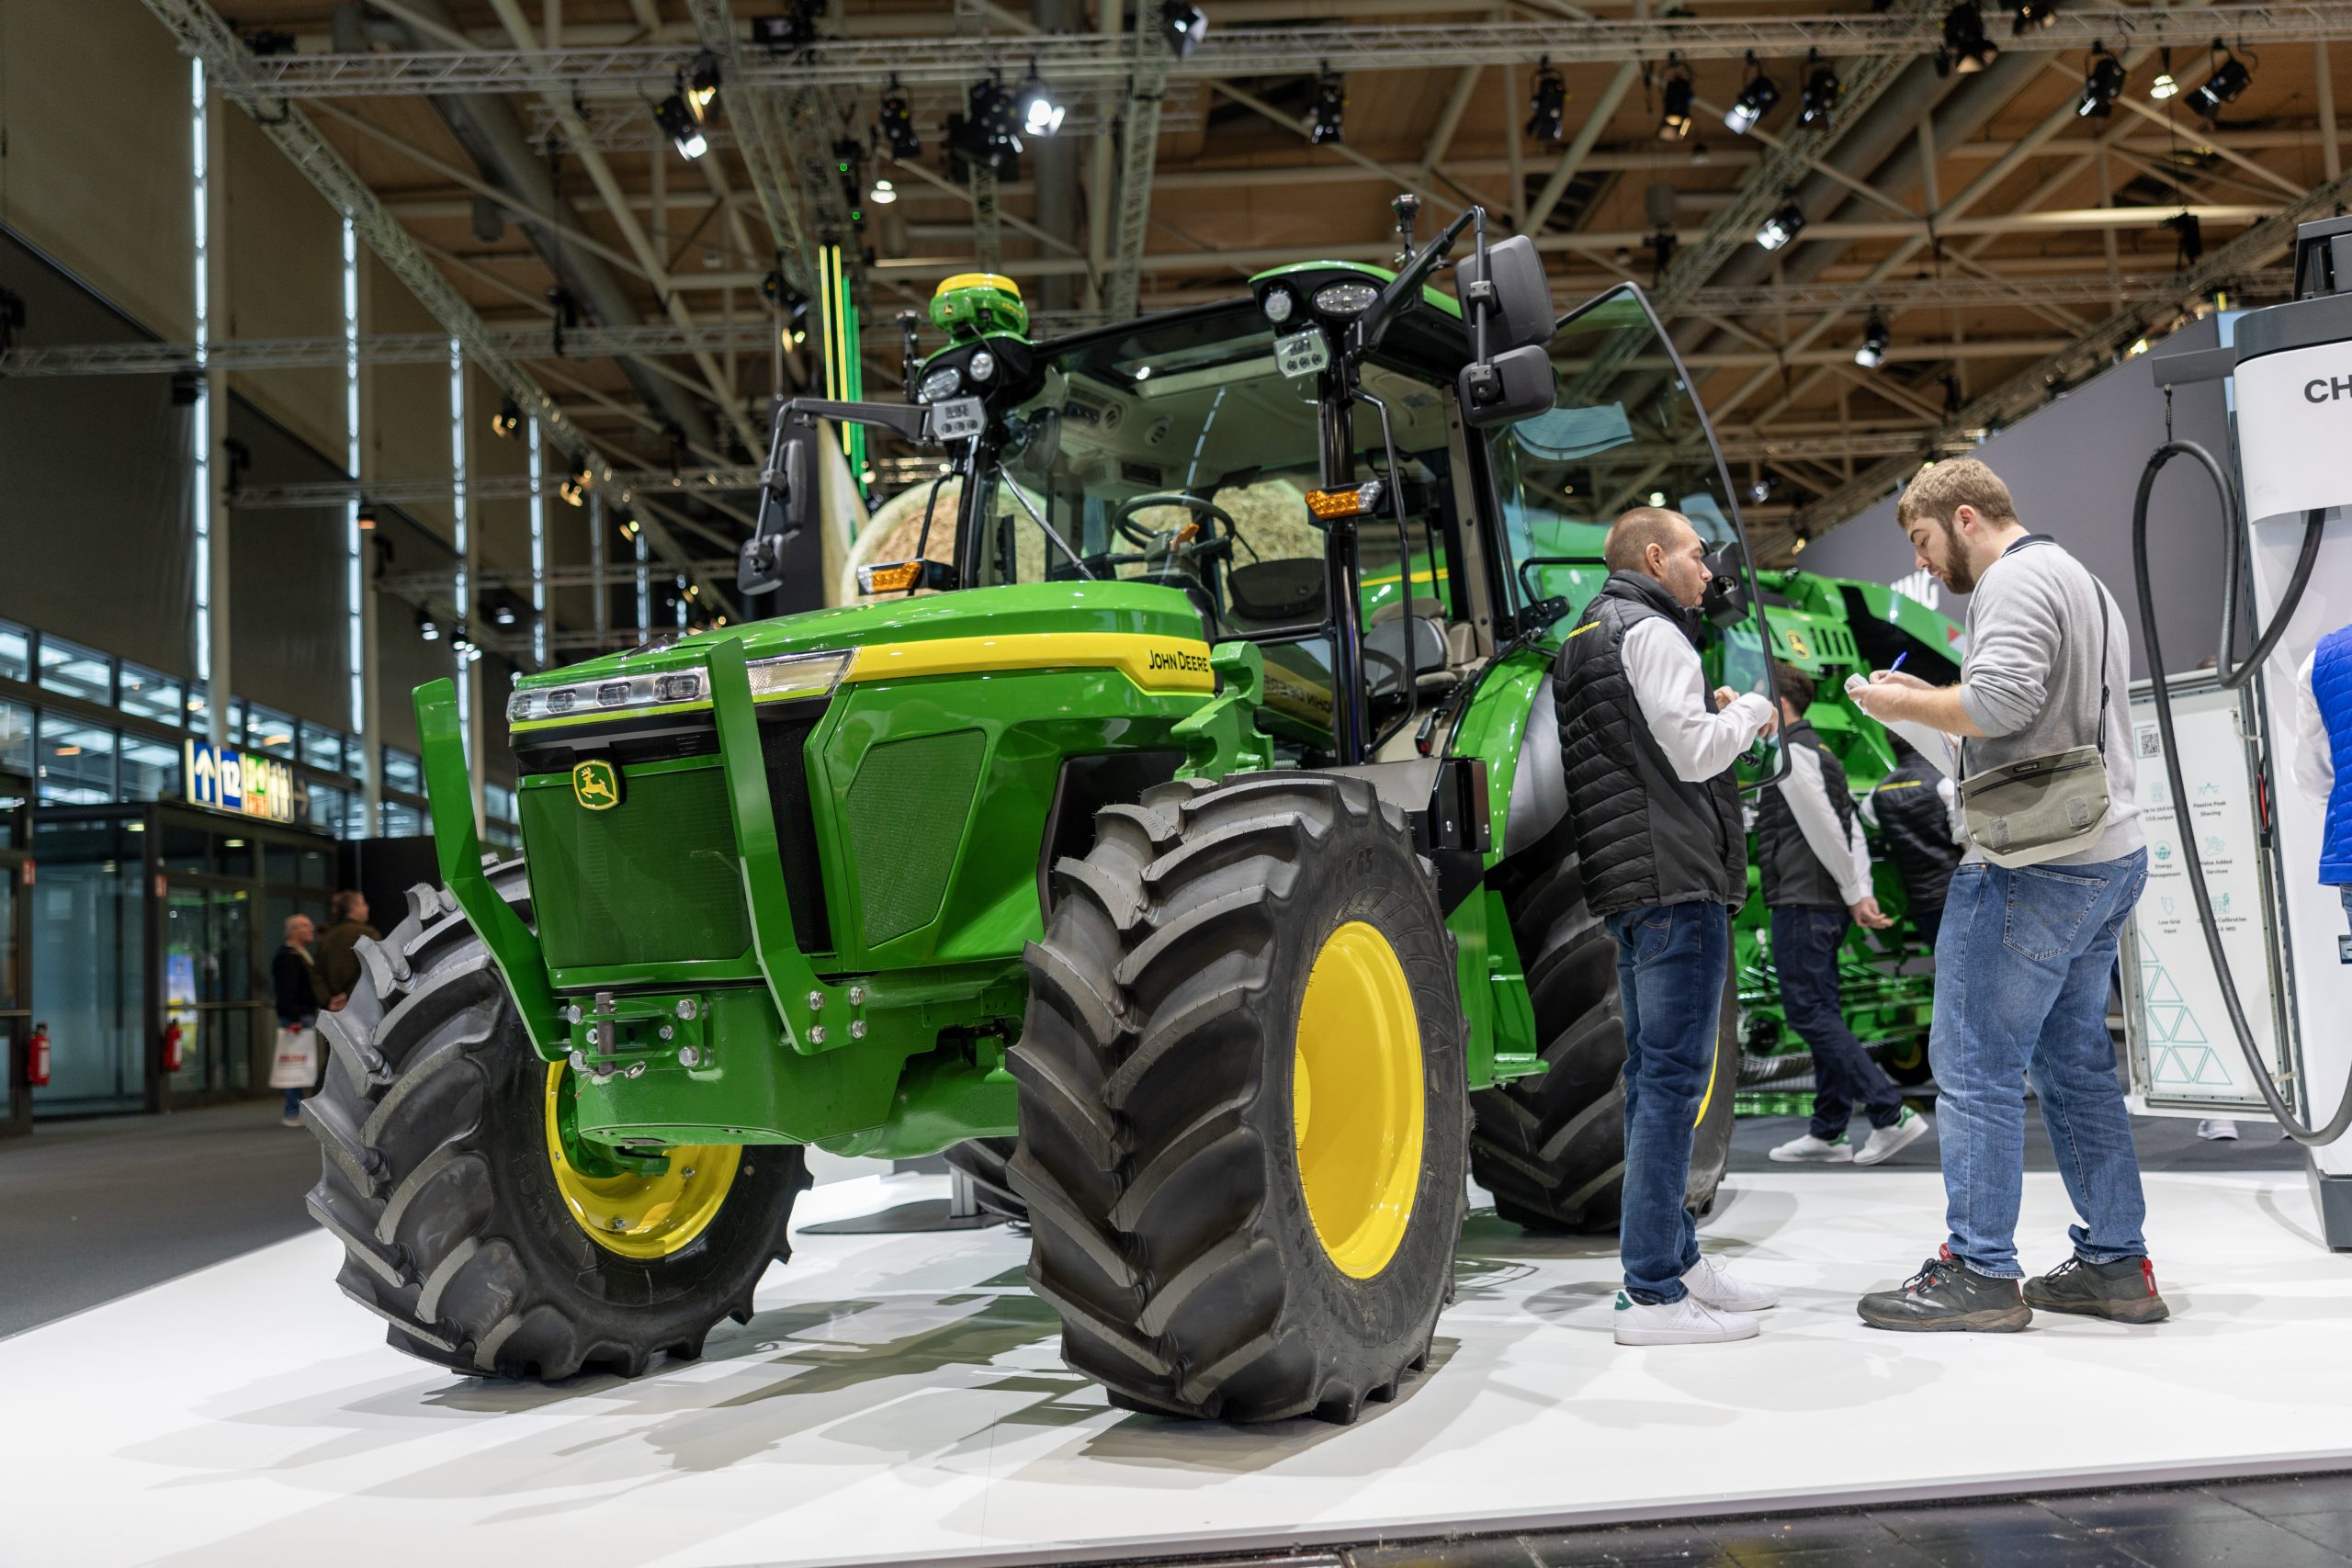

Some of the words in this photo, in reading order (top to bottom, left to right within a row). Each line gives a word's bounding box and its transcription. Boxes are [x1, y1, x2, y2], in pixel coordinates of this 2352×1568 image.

[2304, 375, 2352, 403] CH
[1149, 649, 1177, 670] JOHN
[1177, 651, 1209, 672] DEERE
[221, 760, 241, 798] 12
